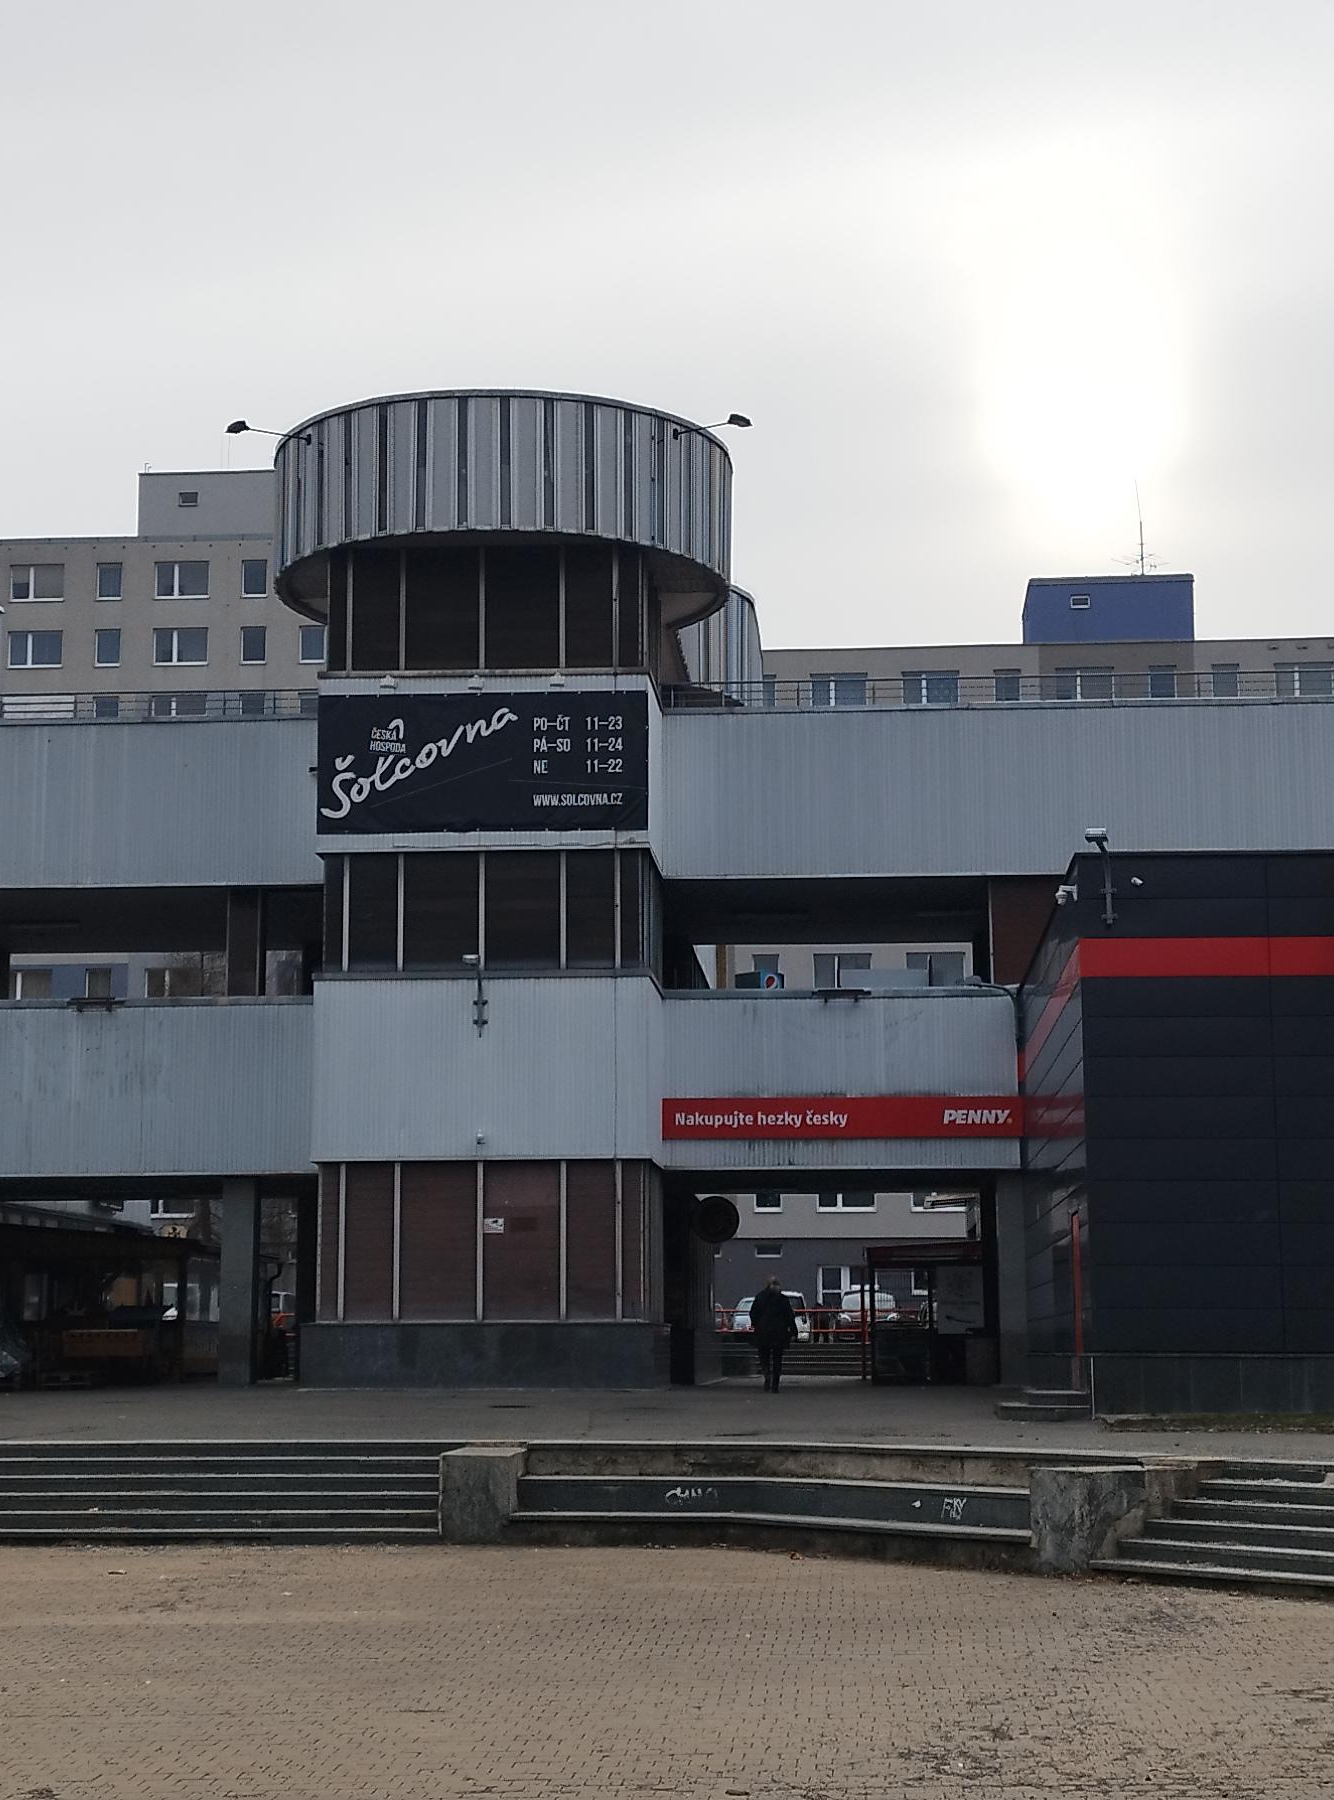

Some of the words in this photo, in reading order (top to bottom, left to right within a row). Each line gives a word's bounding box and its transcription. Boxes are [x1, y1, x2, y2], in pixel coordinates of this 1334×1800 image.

[585, 716, 623, 731] 11-23
[369, 740, 406, 754] HOSPODA
[585, 738, 623, 753] 11-24
[320, 706, 518, 819] Šolcovna
[533, 760, 549, 775] NE
[585, 759, 623, 774] 11-22
[533, 792, 623, 807] WWW.SOLCOVNA.CZ
[674, 1111, 754, 1130] Nakupujte
[757, 1111, 802, 1129] hezky
[806, 1109, 848, 1128] česky
